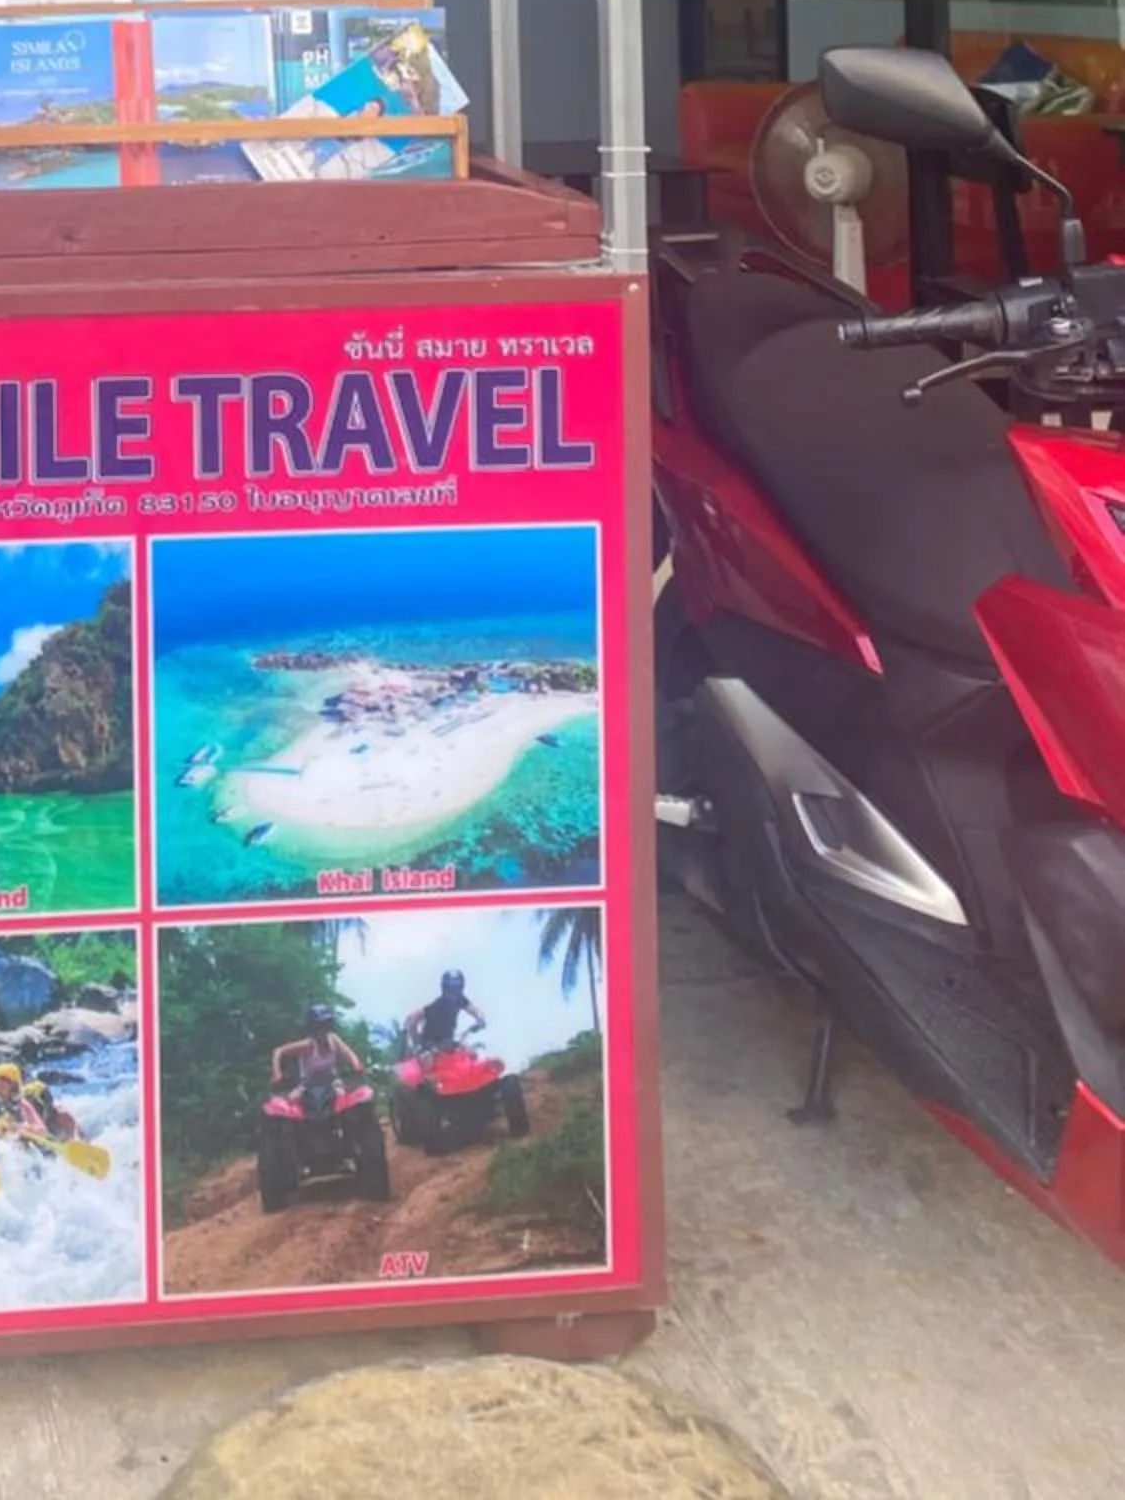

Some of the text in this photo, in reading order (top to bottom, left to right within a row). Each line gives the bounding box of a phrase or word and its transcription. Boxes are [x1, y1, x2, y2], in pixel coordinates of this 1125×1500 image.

[343, 325, 594, 360] ซันนี่ สมาย ทราเวล
[172, 366, 594, 480] TRAVEL
[137, 491, 238, 515] 83150
[317, 862, 455, 894] Khai Island
[379, 1250, 429, 1278] ATV
